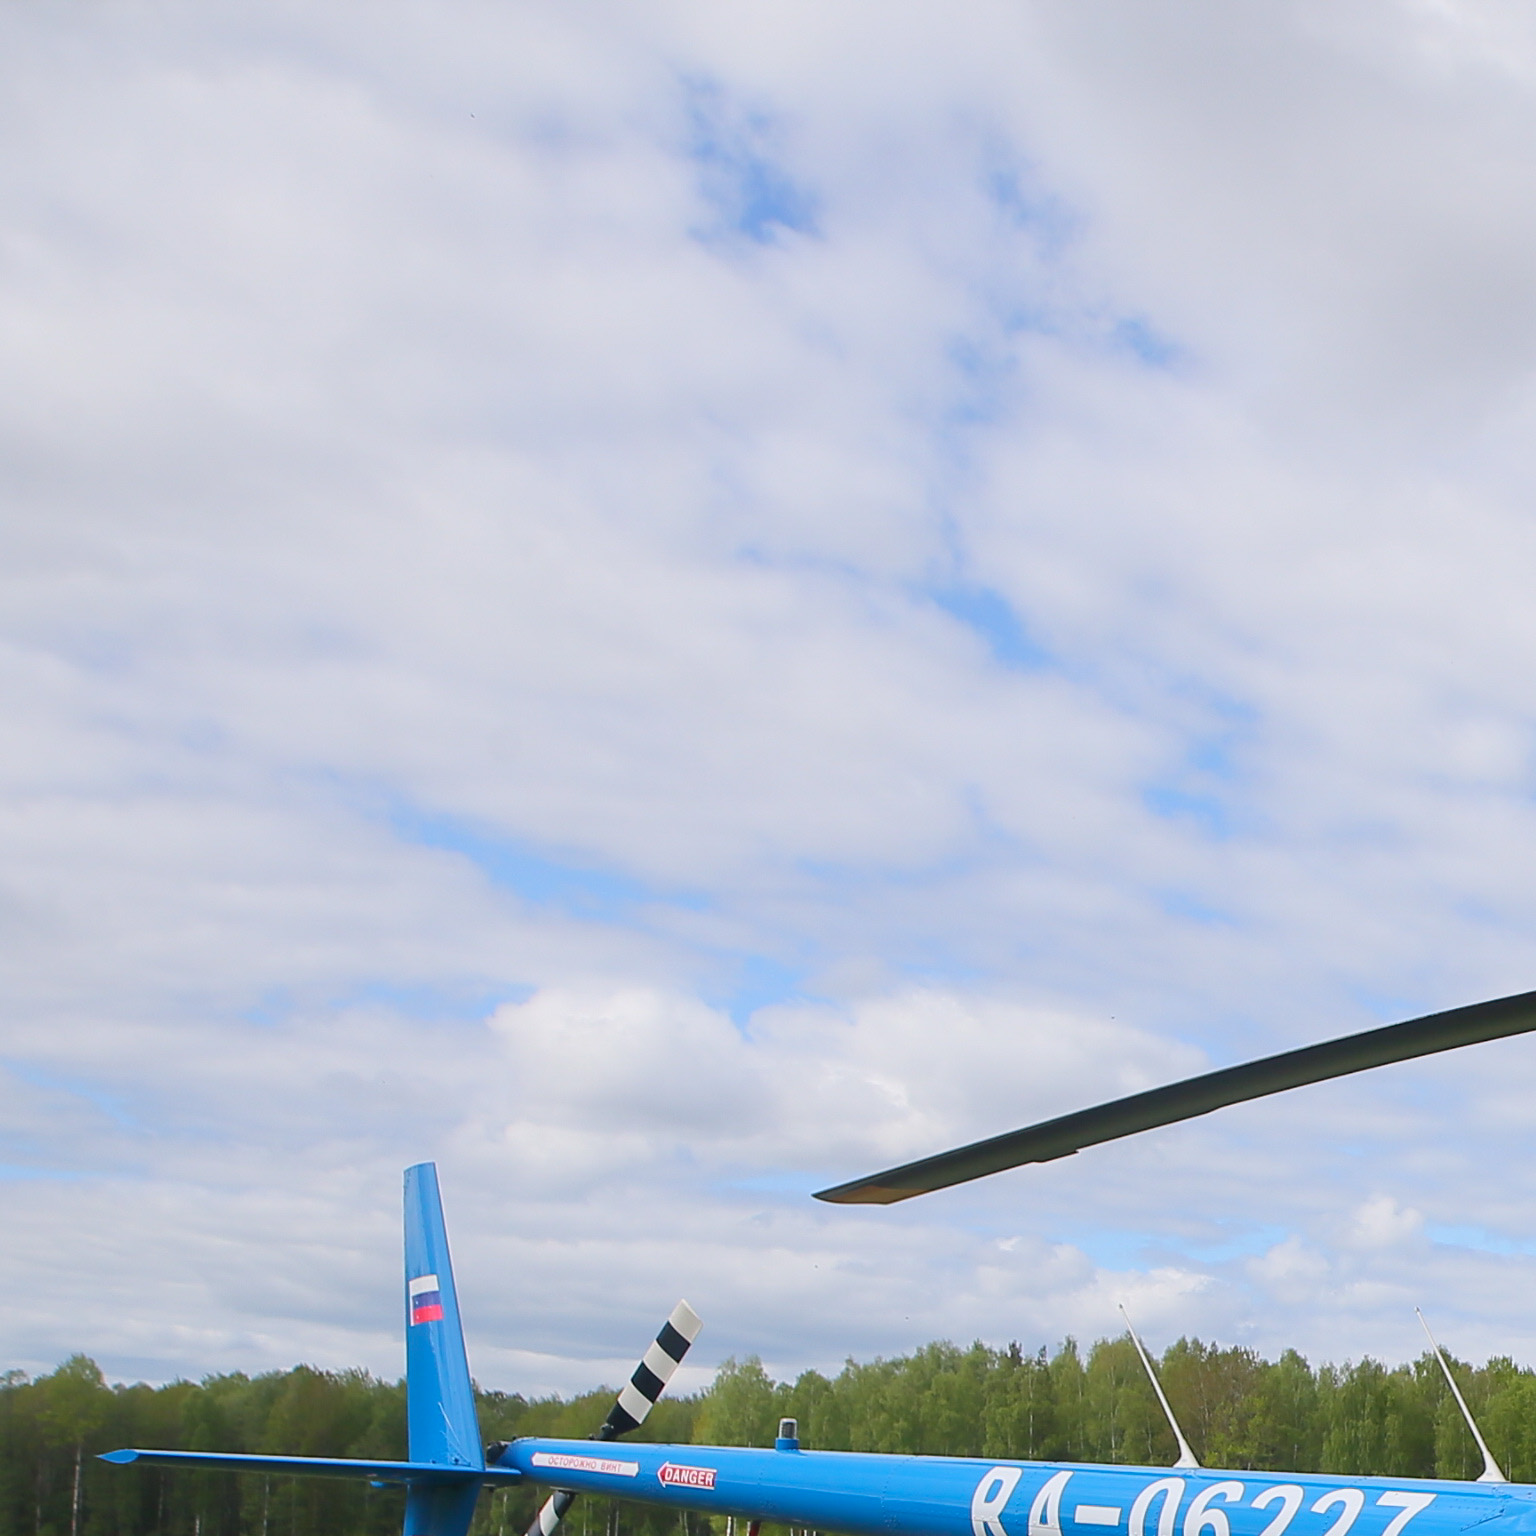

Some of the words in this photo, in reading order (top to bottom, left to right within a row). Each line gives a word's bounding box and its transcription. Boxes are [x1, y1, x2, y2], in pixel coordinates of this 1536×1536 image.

[548, 1456, 597, 1470] ОСТОРОЖНО
[600, 1462, 623, 1473] ВИНТ
[664, 1467, 714, 1487] DANGER
